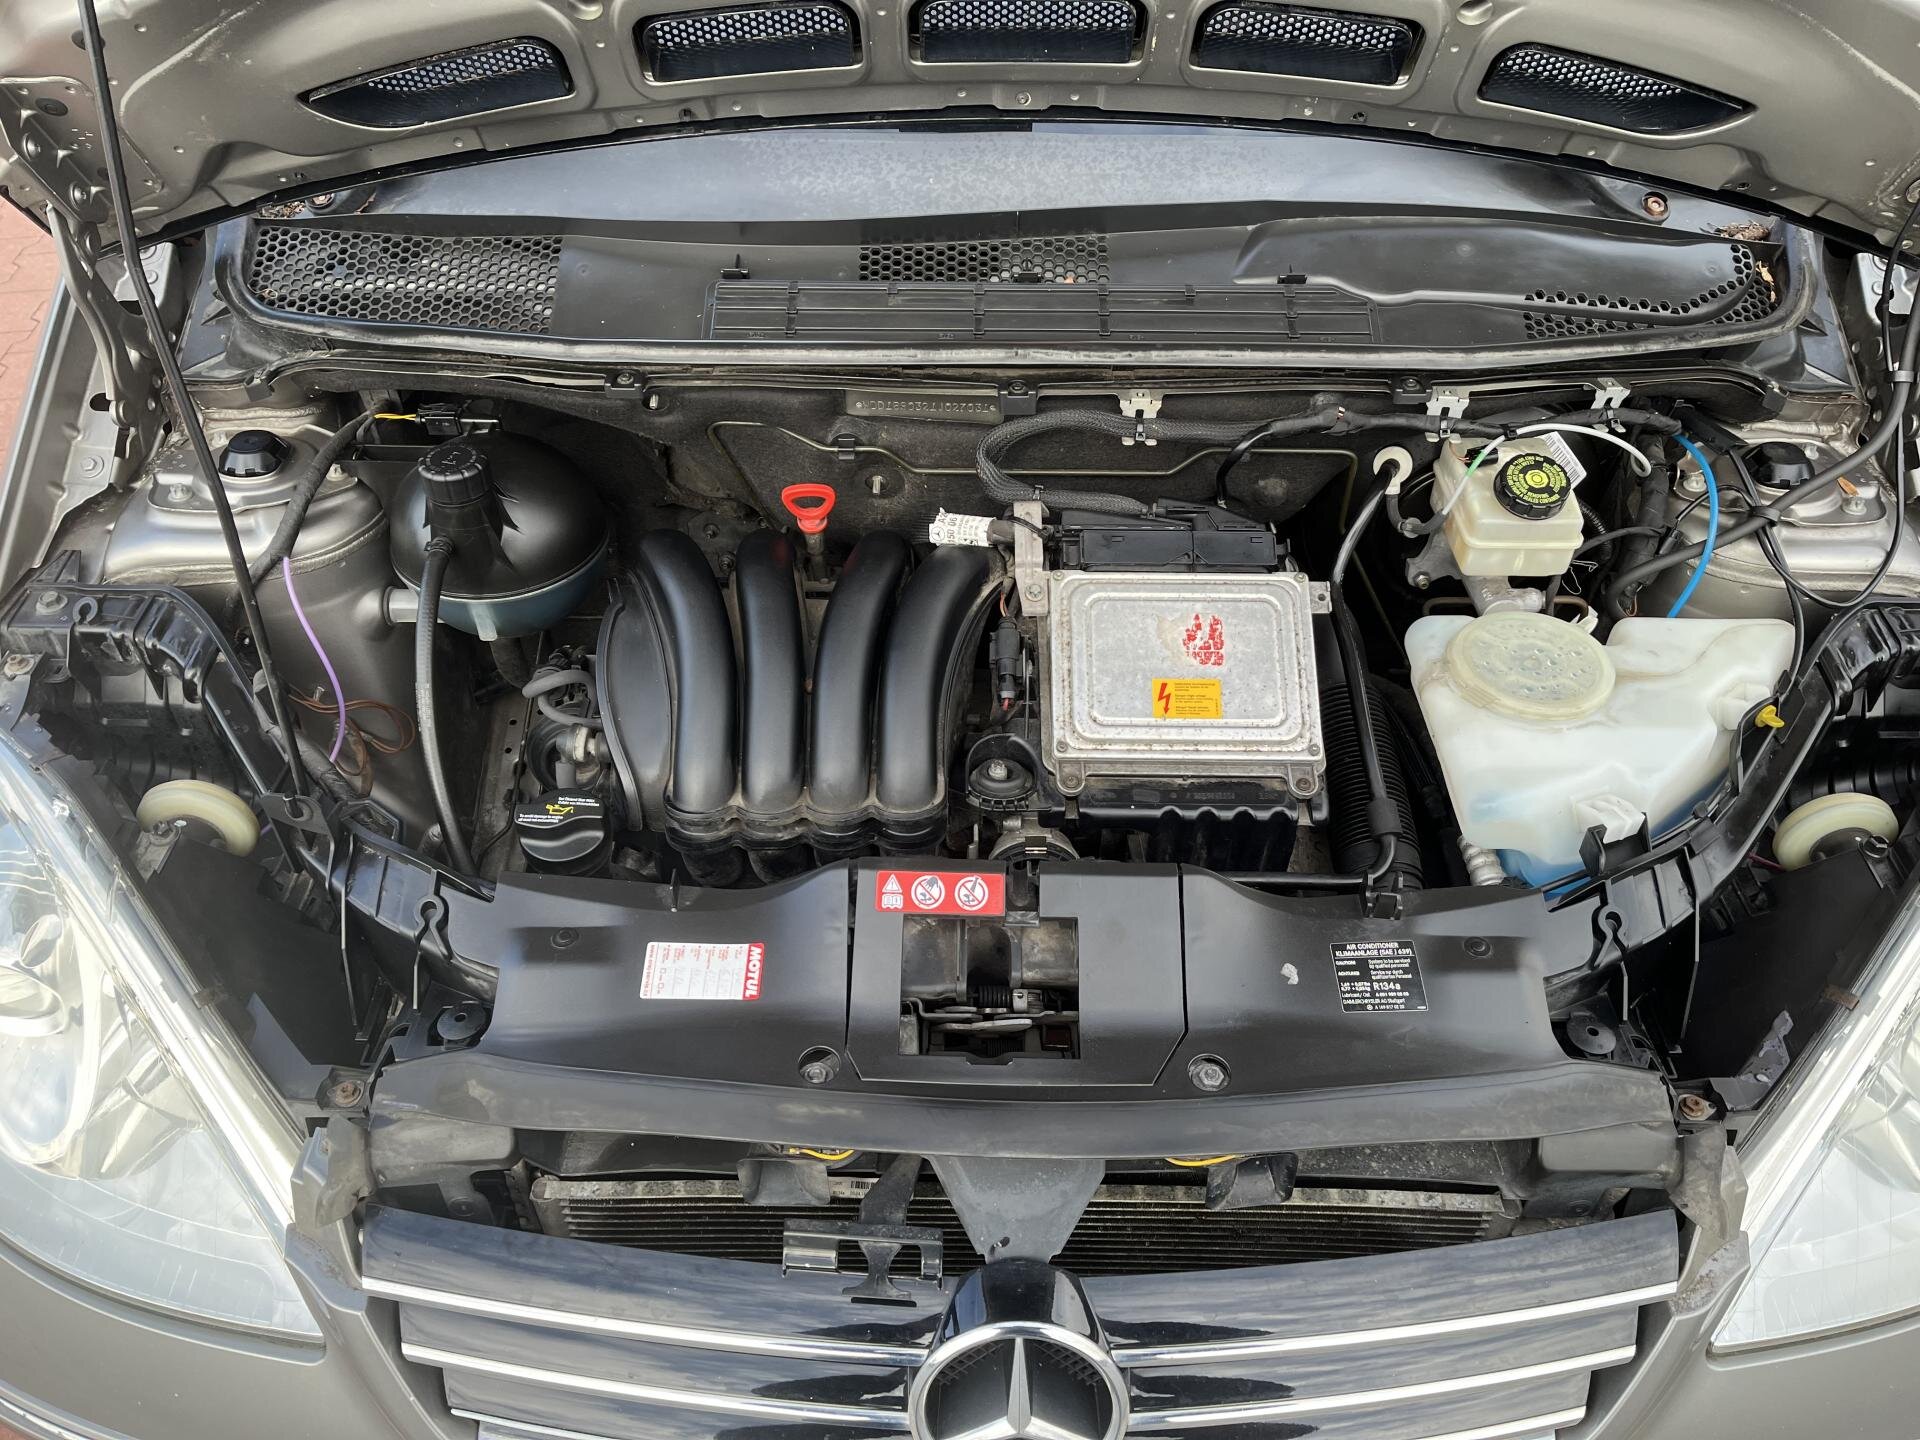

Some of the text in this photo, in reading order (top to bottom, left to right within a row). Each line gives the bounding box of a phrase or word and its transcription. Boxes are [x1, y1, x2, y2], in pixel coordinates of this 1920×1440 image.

[1346, 942, 1399, 951] AIR CONDITIONER
[1335, 949, 1379, 957] KLIMAANLAGE
[744, 945, 763, 998] MOTUL
